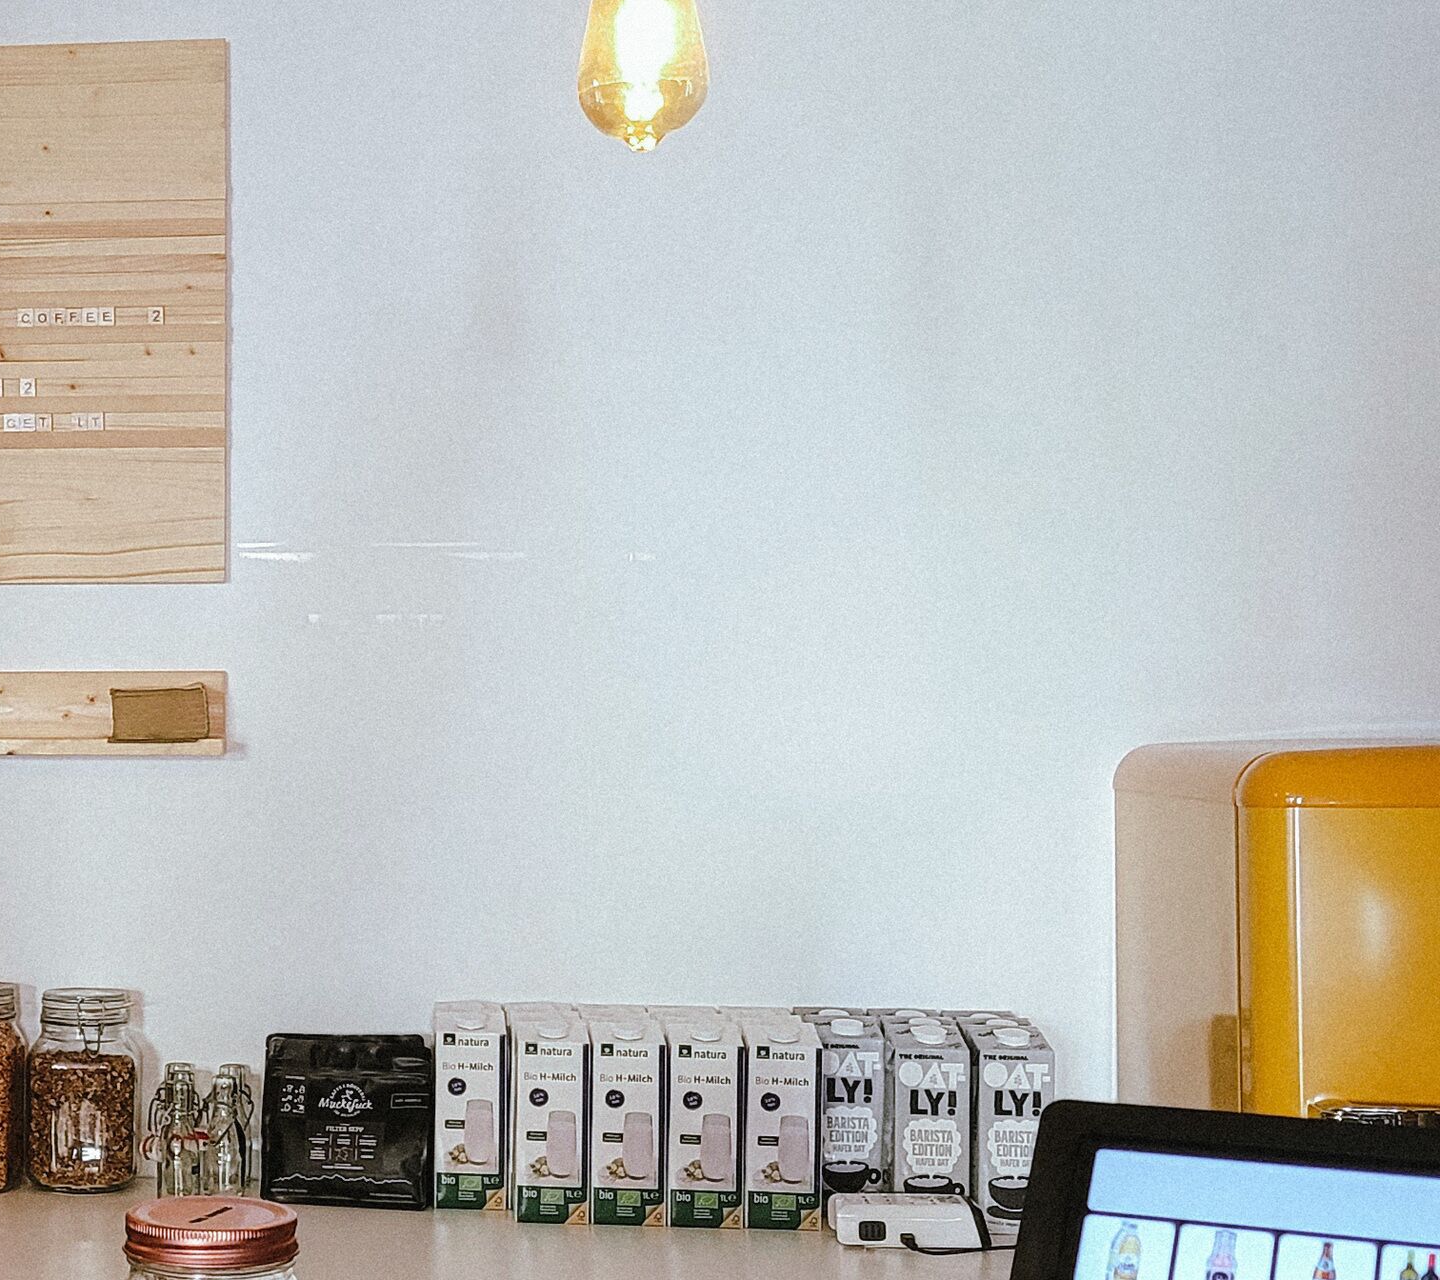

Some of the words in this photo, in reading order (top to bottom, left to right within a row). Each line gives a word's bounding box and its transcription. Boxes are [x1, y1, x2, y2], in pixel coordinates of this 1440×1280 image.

[20, 310, 115, 324] COFFEE
[149, 309, 161, 323] 2
[23, 381, 34, 395] 2
[6, 416, 50, 429] GET
[457, 1037, 490, 1048] natura
[540, 1047, 573, 1057] natura
[615, 1048, 649, 1058] natura
[693, 1049, 727, 1060] natura
[771, 1051, 806, 1061] natura
[441, 1062, 456, 1071] Bio
[458, 1062, 495, 1072] H-Milch
[523, 1071, 538, 1081] Bio
[539, 1072, 577, 1082] H-Milch
[599, 1073, 614, 1082] Bio
[615, 1073, 653, 1083] H-Milch
[677, 1074, 692, 1084] Bio
[693, 1075, 732, 1085] H-Milch
[755, 1076, 770, 1085] Bio
[771, 1077, 810, 1087] H-Milch
[826, 1077, 873, 1104] LY!
[318, 1097, 374, 1113] Muckefuck
[910, 1089, 957, 1117] LY!
[994, 1090, 1042, 1117] LY!
[826, 1116, 870, 1130] BARISTA
[829, 1130, 868, 1143] EDITION
[910, 1129, 954, 1143] BARISTA
[994, 1130, 1033, 1144] BARIST
[912, 1143, 952, 1157] EDITION
[996, 1144, 1030, 1158] EDITIO
[441, 1174, 456, 1185] bio
[522, 1187, 537, 1199] bio
[599, 1189, 614, 1200] bio
[676, 1192, 691, 1202] bio
[753, 1194, 768, 1204] bio
